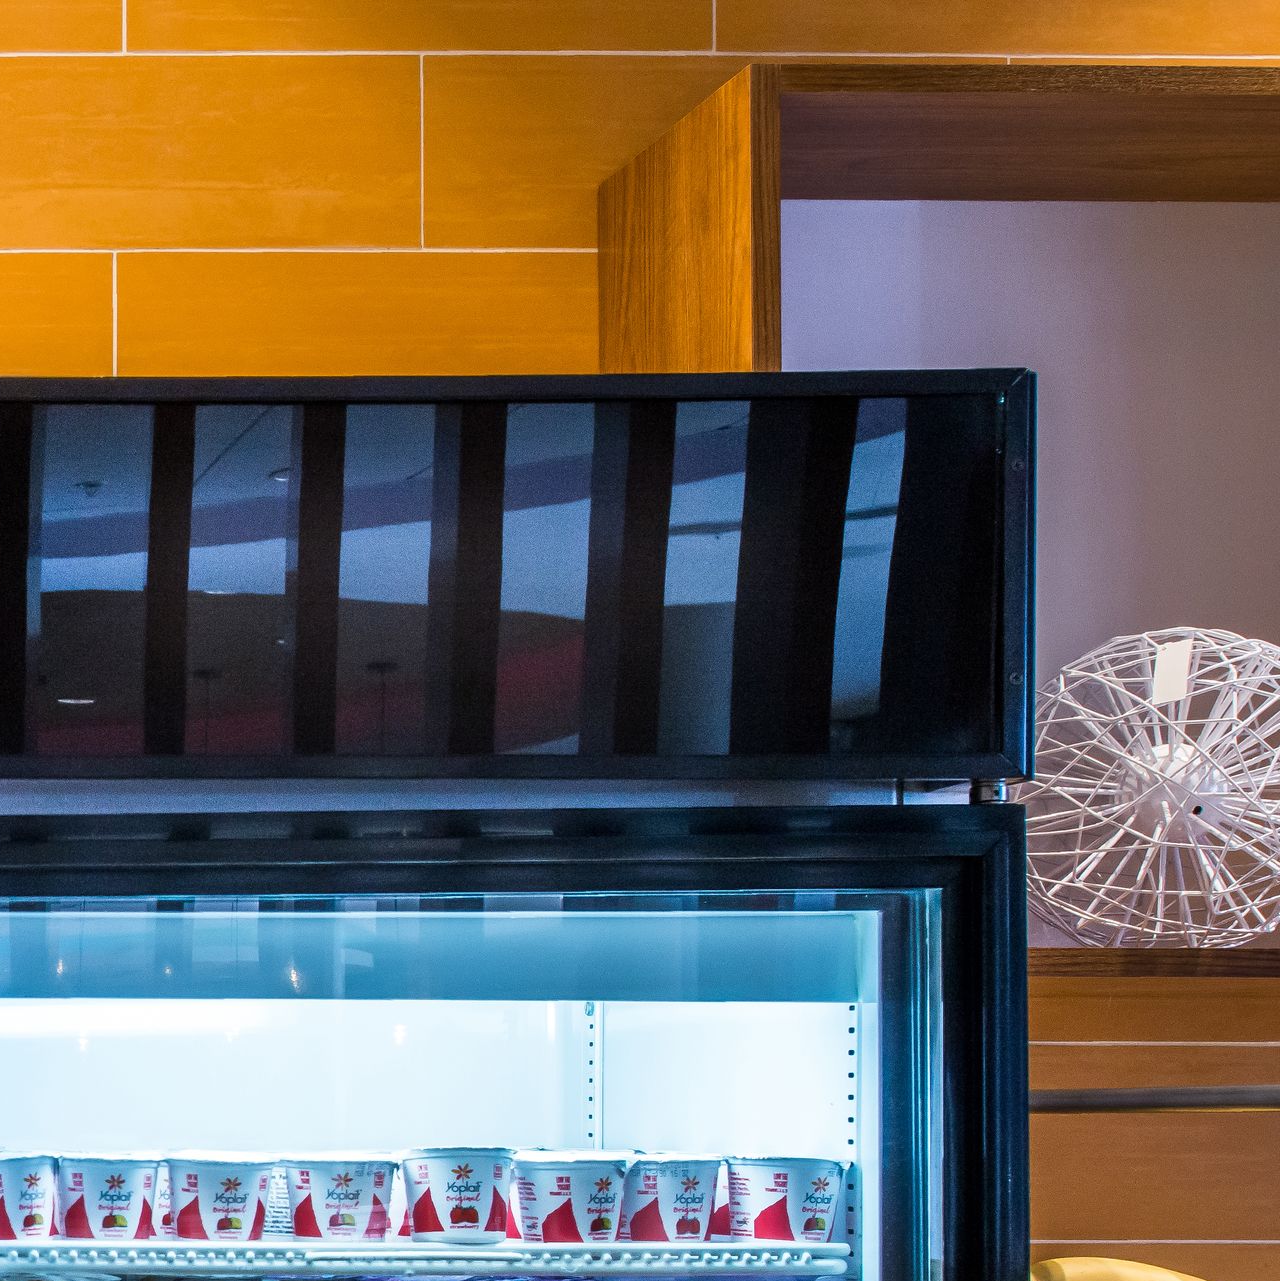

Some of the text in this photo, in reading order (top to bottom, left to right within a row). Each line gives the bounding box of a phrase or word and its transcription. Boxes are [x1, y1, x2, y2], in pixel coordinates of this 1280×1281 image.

[325, 1188, 363, 1202] Yoplait
[445, 1181, 483, 1196] Yoplait
[673, 1192, 706, 1206] Yoplait
[804, 1193, 835, 1205] Yoplait
